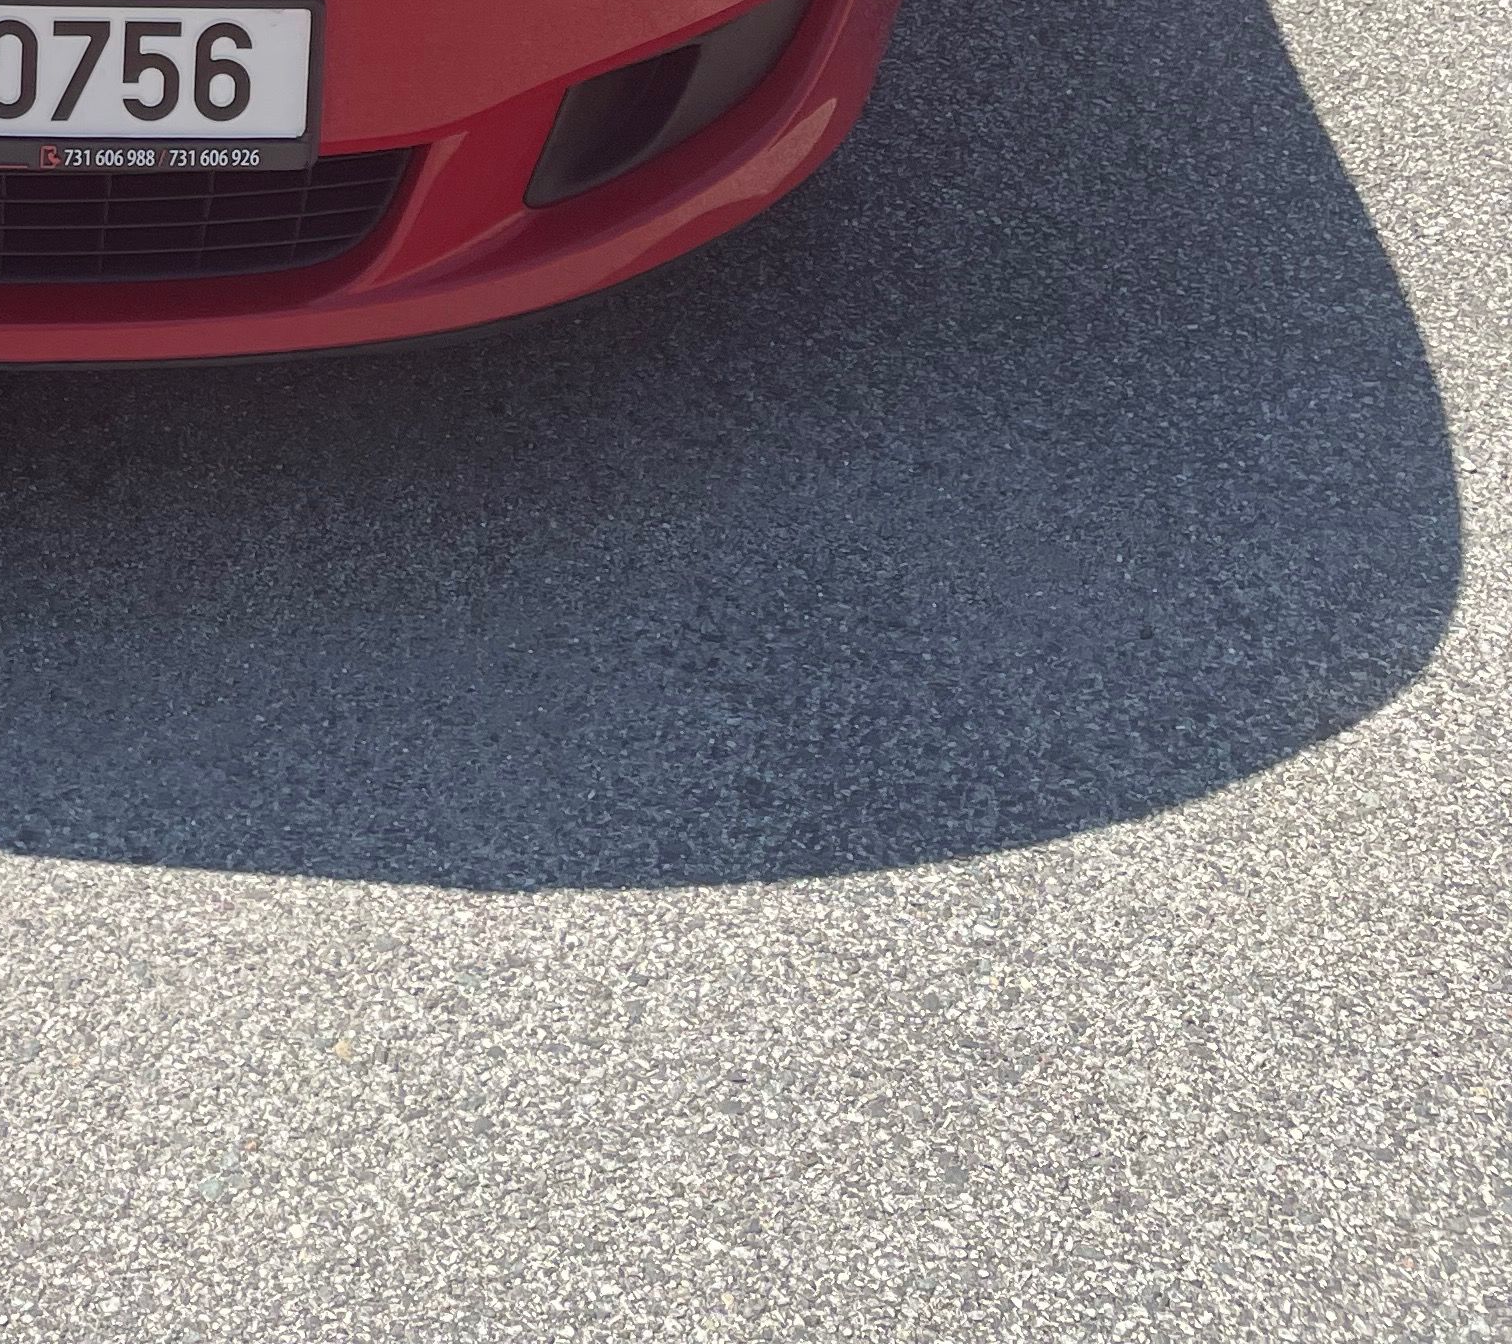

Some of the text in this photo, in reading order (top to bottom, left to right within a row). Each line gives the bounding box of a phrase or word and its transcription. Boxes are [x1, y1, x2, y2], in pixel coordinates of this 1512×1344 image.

[64, 149, 91, 167] 731
[95, 149, 124, 167] 606
[127, 149, 156, 167] 988
[169, 149, 196, 167] 731
[200, 149, 229, 167] 606
[232, 149, 260, 167] 926
